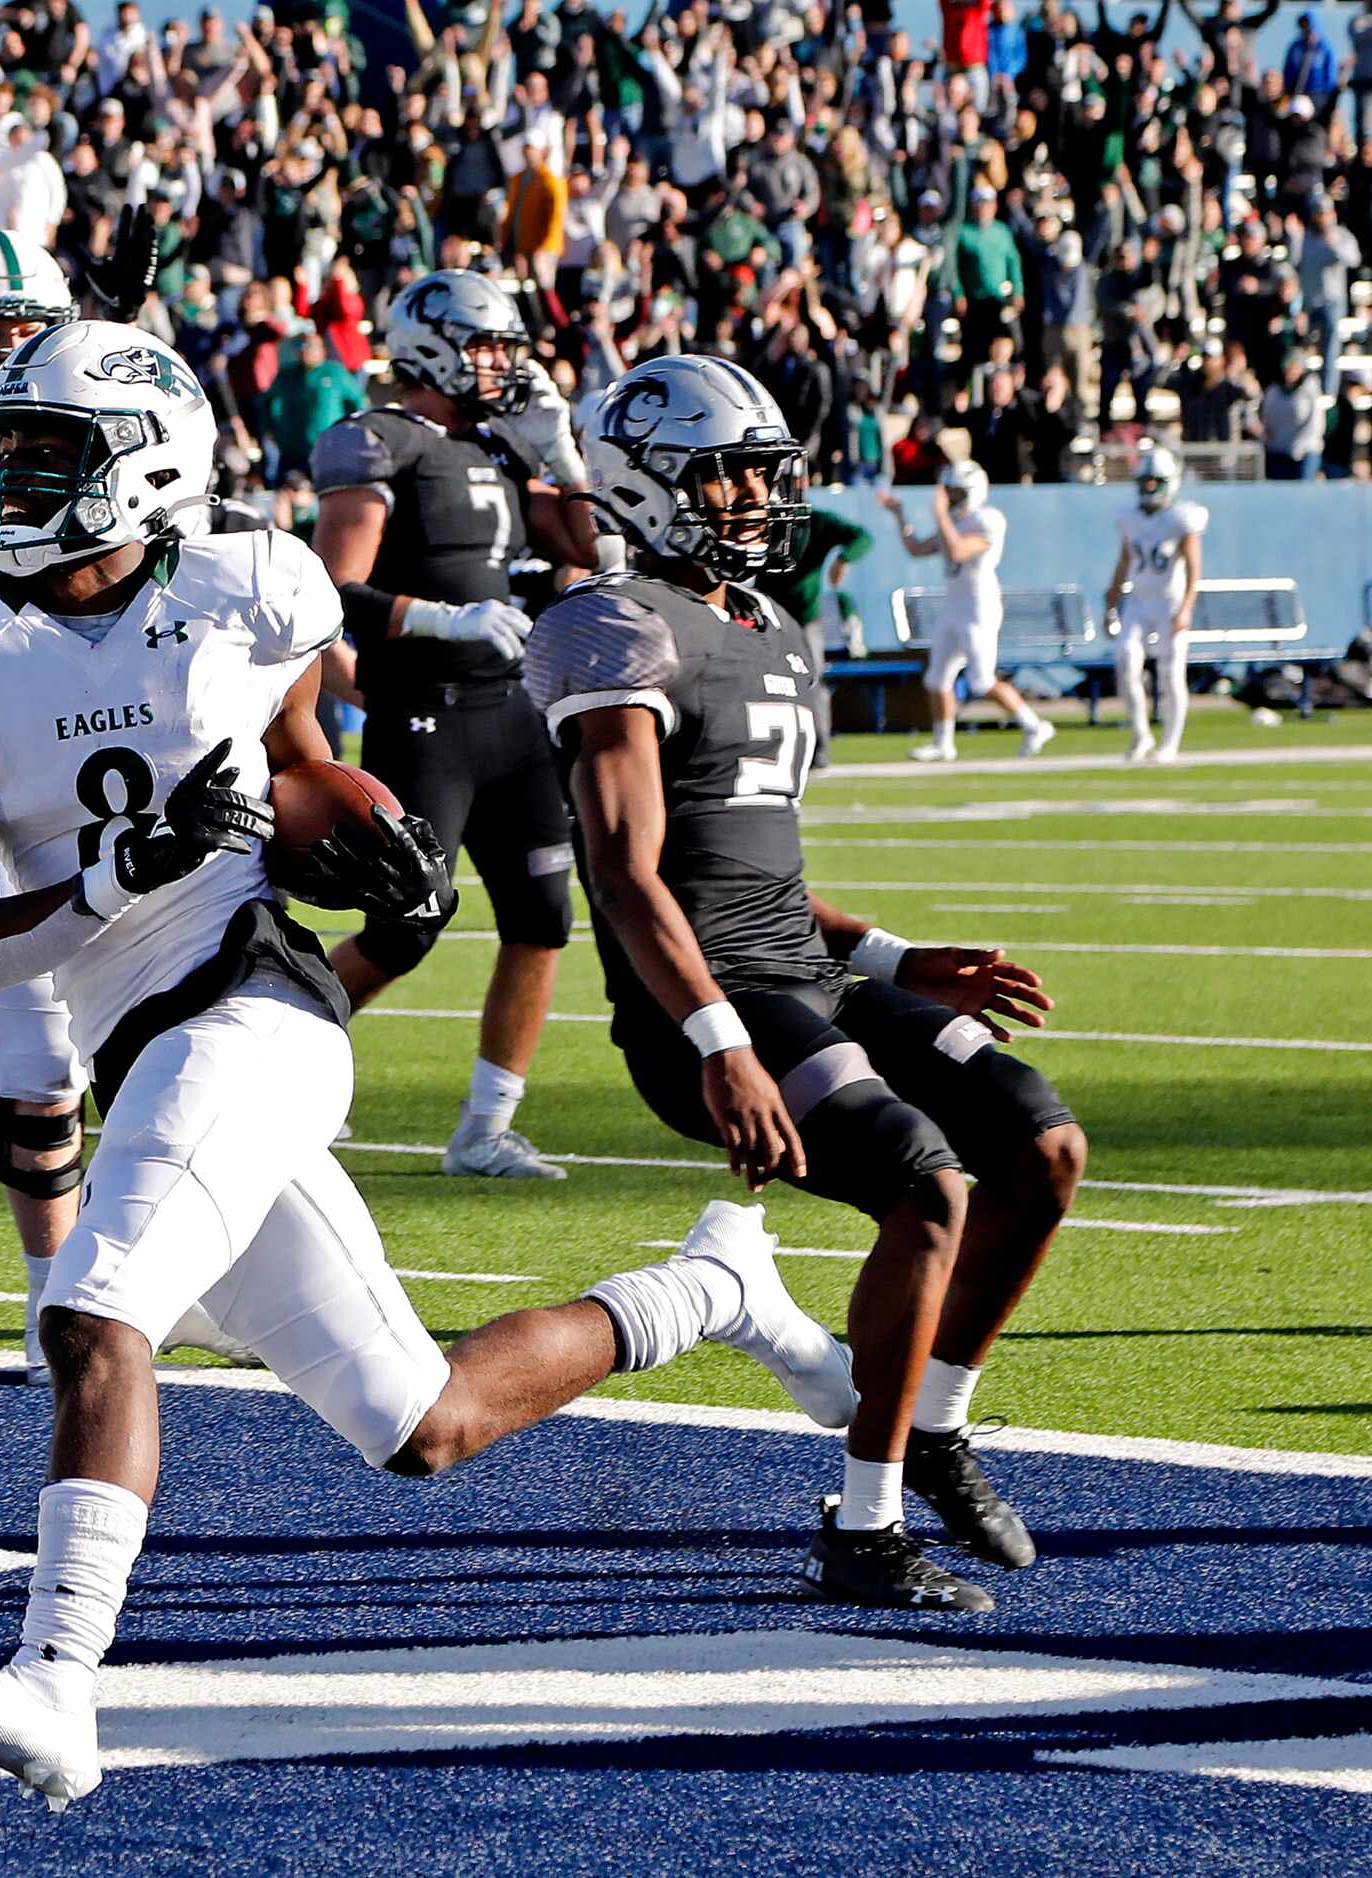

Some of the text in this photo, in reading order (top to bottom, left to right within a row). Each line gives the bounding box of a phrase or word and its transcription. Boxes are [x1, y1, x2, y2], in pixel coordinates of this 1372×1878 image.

[467, 485, 512, 570] 7
[56, 703, 154, 740] EAGLES
[724, 701, 817, 809] 21
[76, 746, 161, 870] 8
